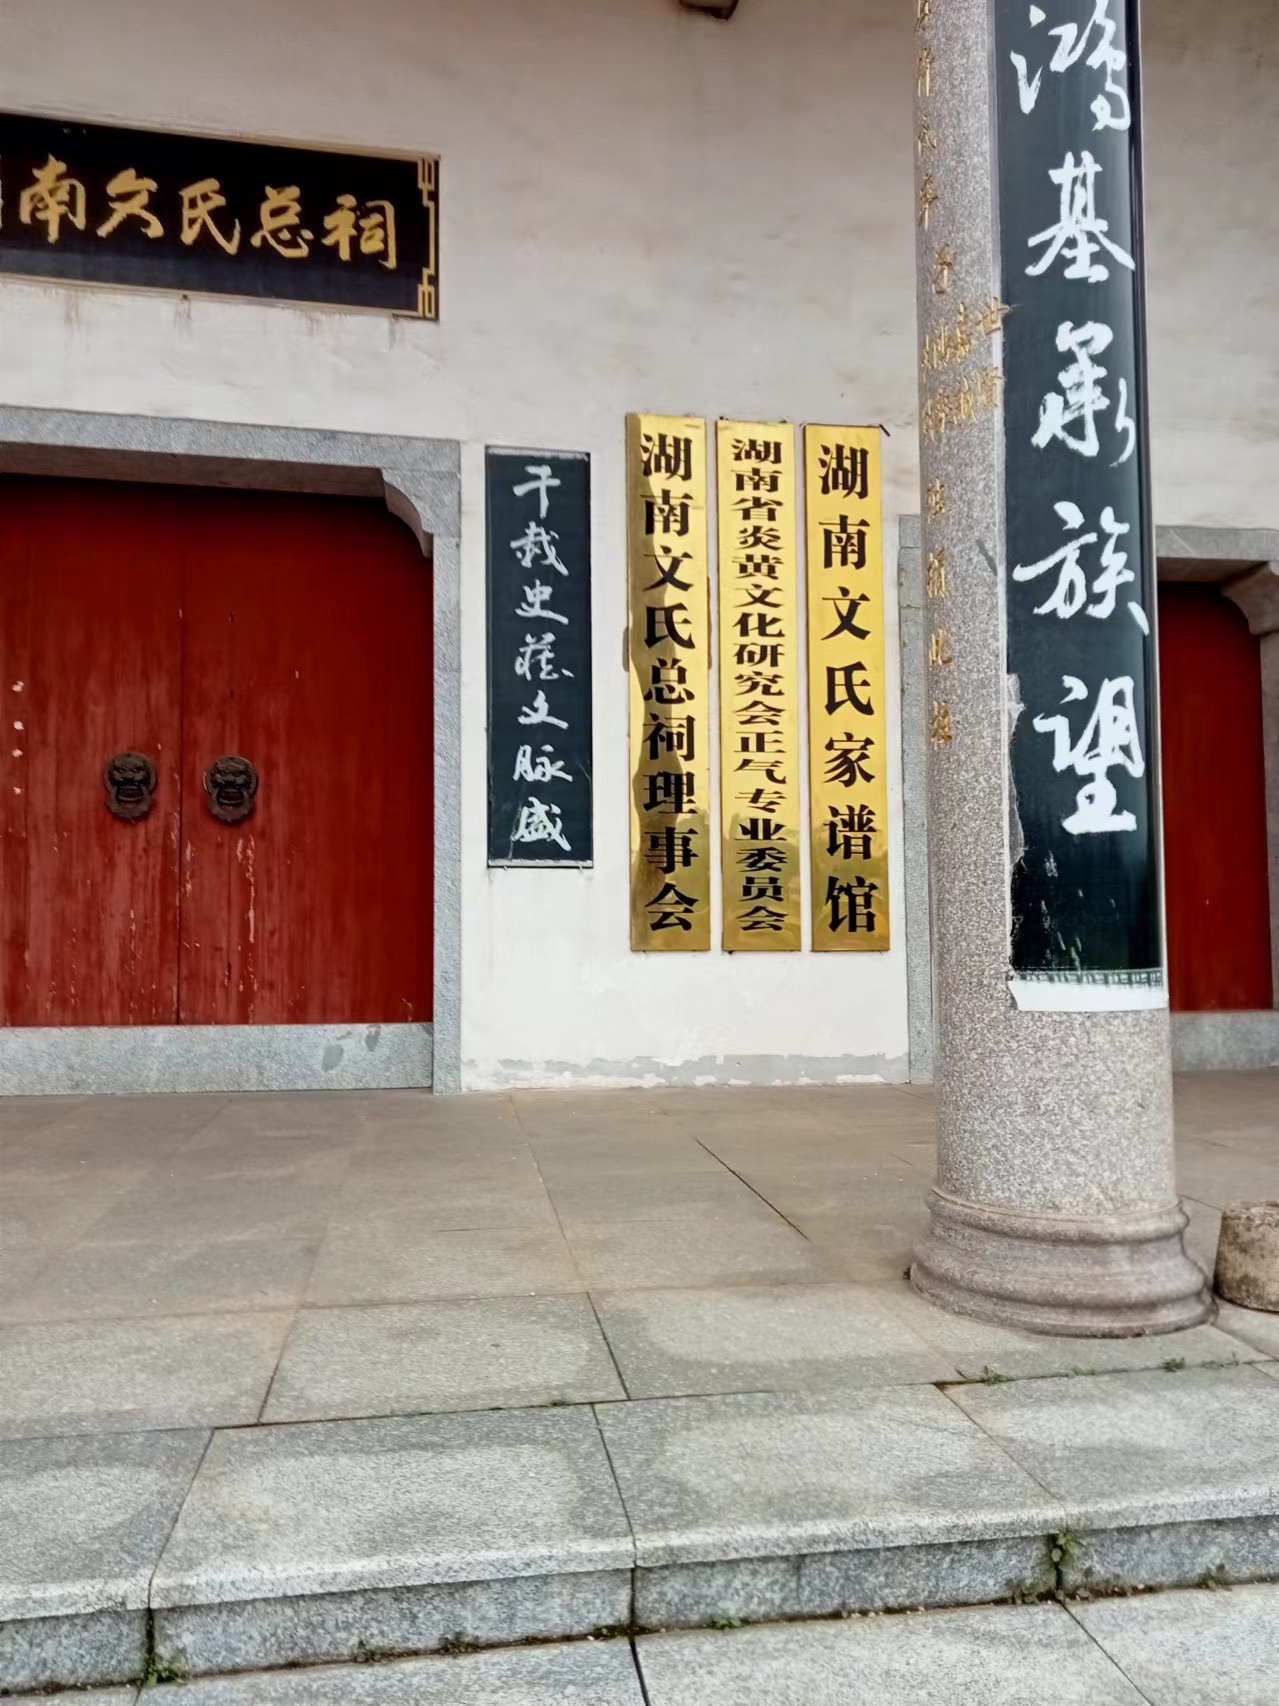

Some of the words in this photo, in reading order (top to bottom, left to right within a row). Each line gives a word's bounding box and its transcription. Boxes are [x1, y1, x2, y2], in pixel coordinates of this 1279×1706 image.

[0, 152, 397, 270] 南文氏总祠
[639, 432, 699, 932] 湖南文氏总祠理事会
[730, 437, 789, 932] 湖南省炎黄文化研究会正气专业委员会
[818, 444, 877, 934] 湖南文氏家谱馆
